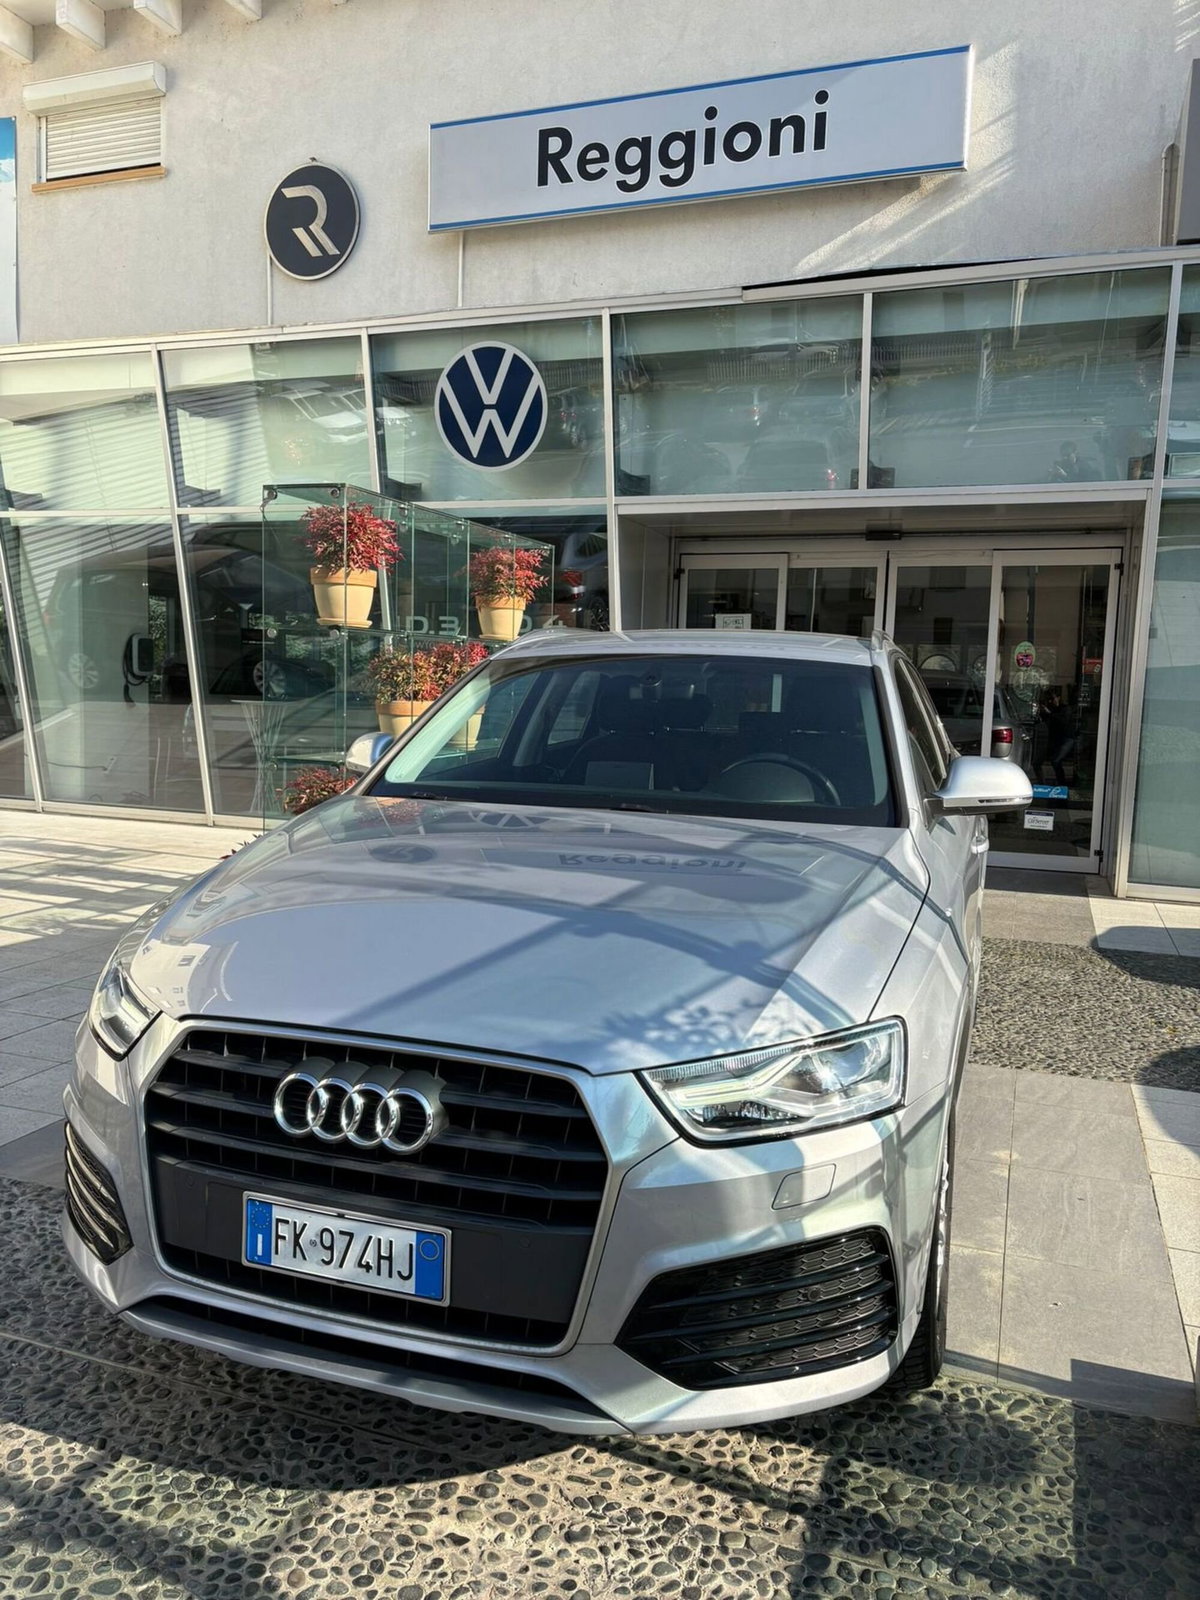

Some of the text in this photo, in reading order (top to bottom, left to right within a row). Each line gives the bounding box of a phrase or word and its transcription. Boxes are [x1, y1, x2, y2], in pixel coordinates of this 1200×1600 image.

[536, 89, 829, 193] Reggioni
[274, 1217, 414, 1281] FK 974HJ
